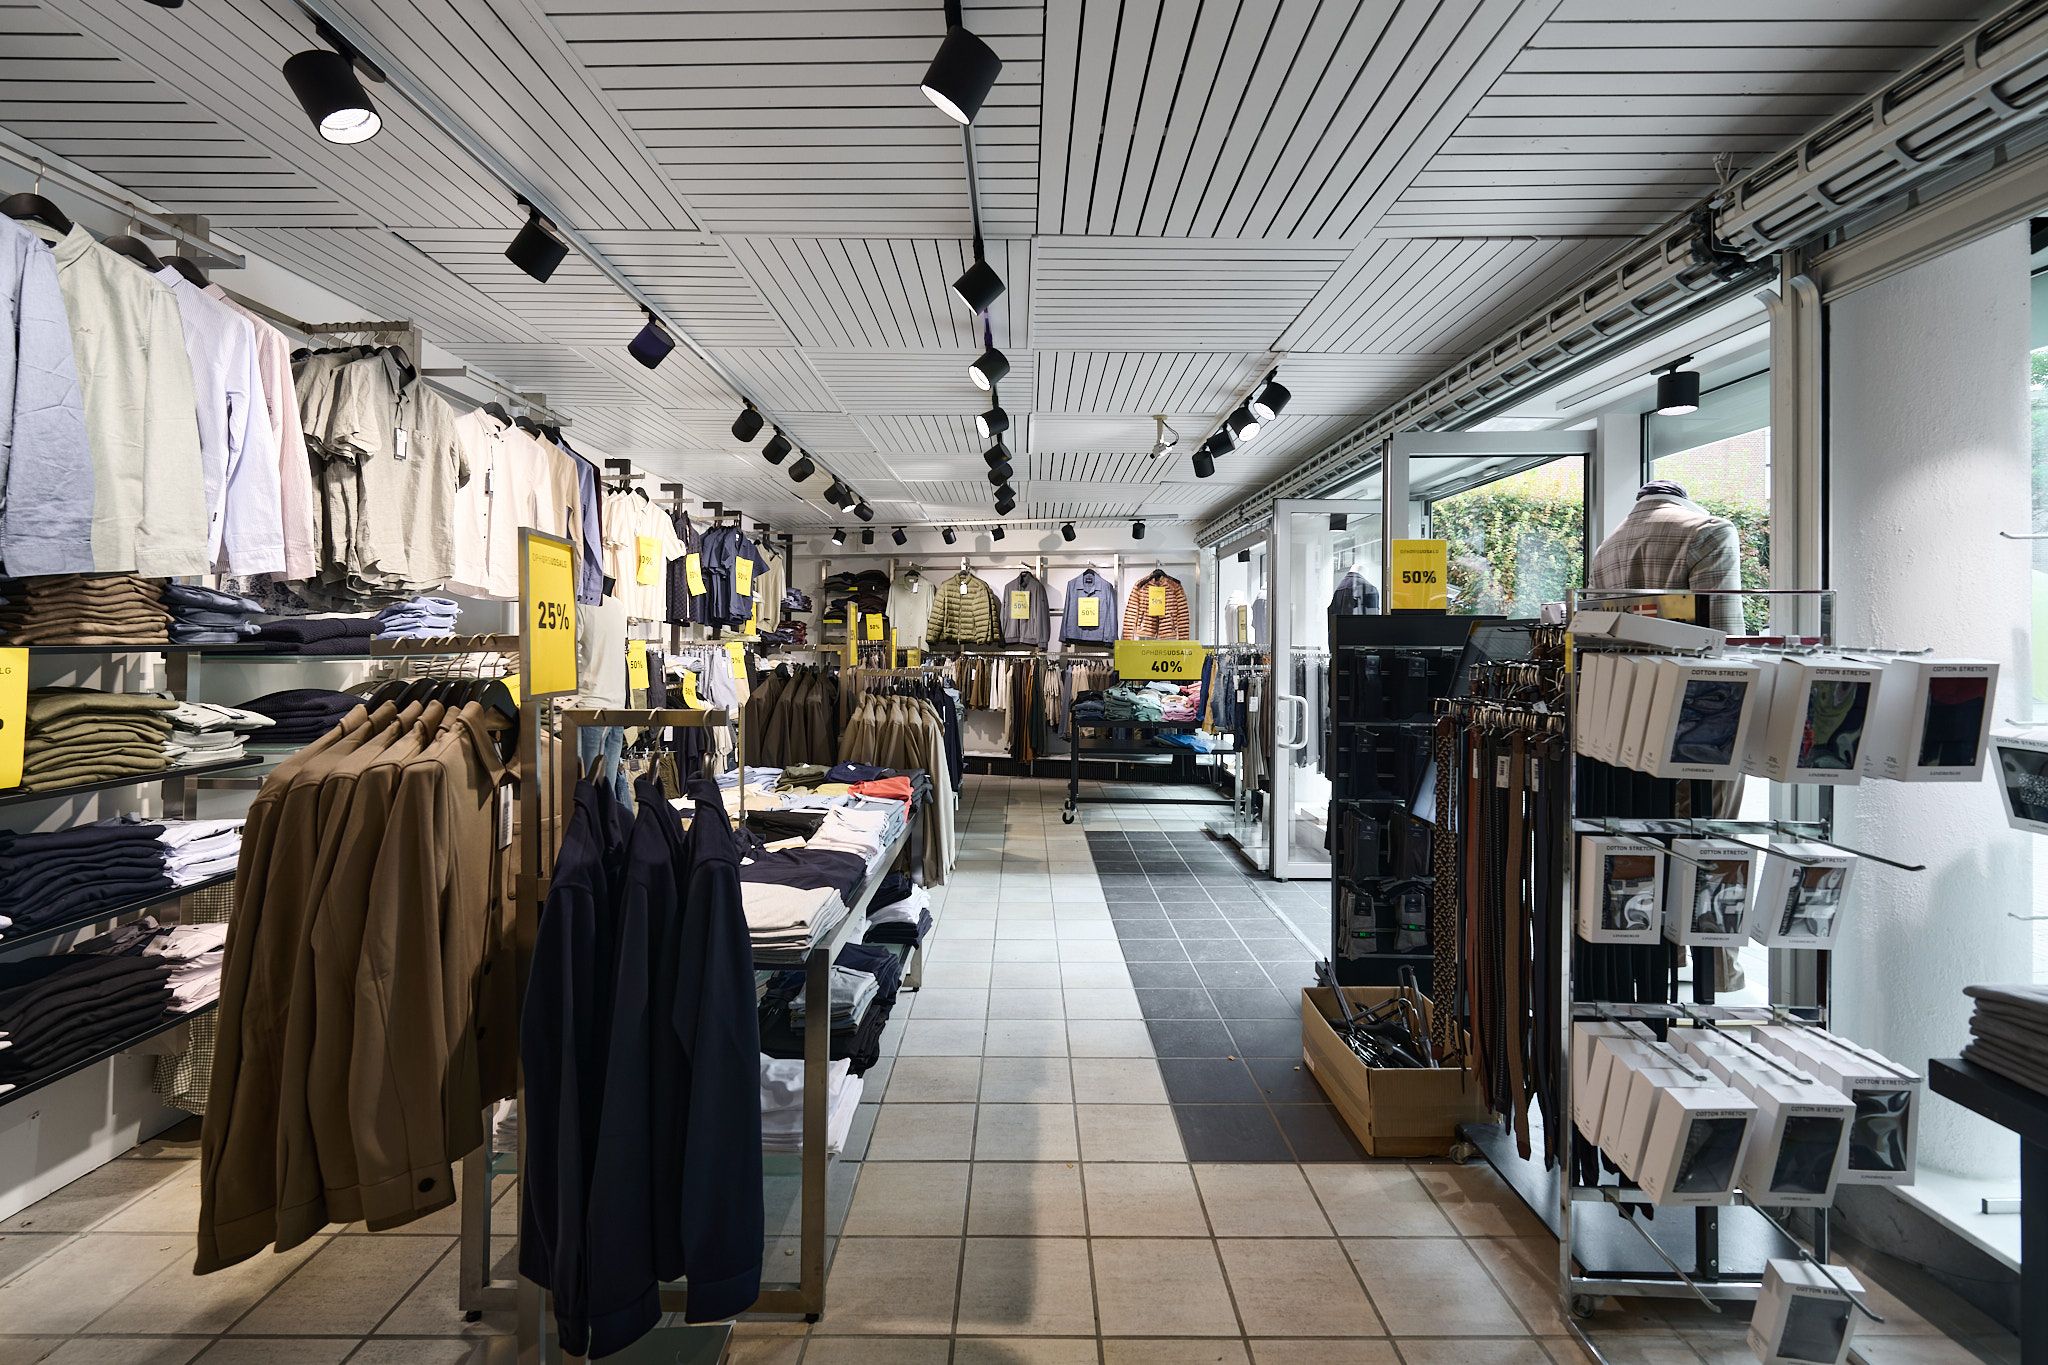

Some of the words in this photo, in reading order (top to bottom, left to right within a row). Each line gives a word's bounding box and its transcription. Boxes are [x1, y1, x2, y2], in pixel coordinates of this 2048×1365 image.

[1402, 570, 1437, 584] 50%
[538, 601, 569, 630] 25%
[630, 660, 643, 669] 50%
[1151, 660, 1182, 673] 40%
[1718, 669, 1748, 677] STRETCH
[1815, 668, 1840, 676] COTTON
[1841, 669, 1871, 677] STRETCH
[1796, 1286, 1821, 1294] COTTON
